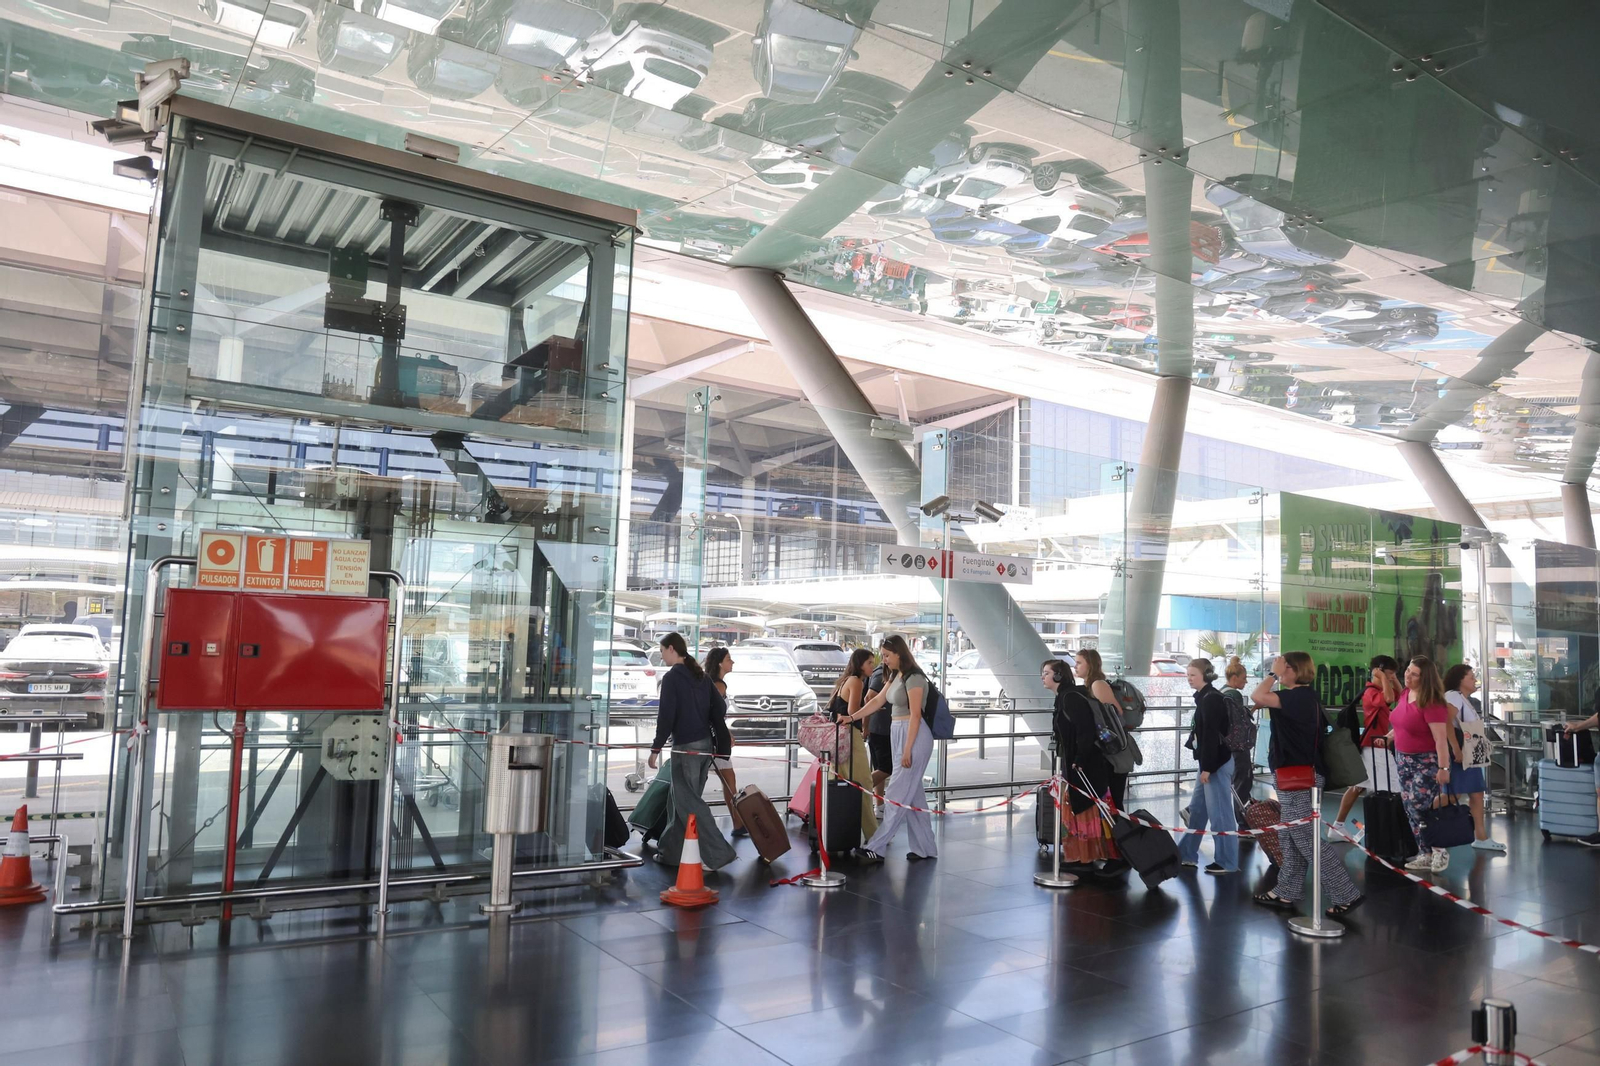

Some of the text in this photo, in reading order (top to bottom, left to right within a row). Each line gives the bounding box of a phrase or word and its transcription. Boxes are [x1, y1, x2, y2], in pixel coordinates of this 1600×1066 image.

[962, 556, 995, 568] Fuengirola
[336, 564, 362, 572] TENSIÓN
[999, 565, 1004, 573] 1
[201, 574, 237, 585] PULSADOR
[246, 576, 281, 587] EXTINTOR
[288, 577, 324, 588] MANGUERA
[1343, 593, 1369, 614] WILD
[1310, 612, 1366, 635] IS LIVING IT
